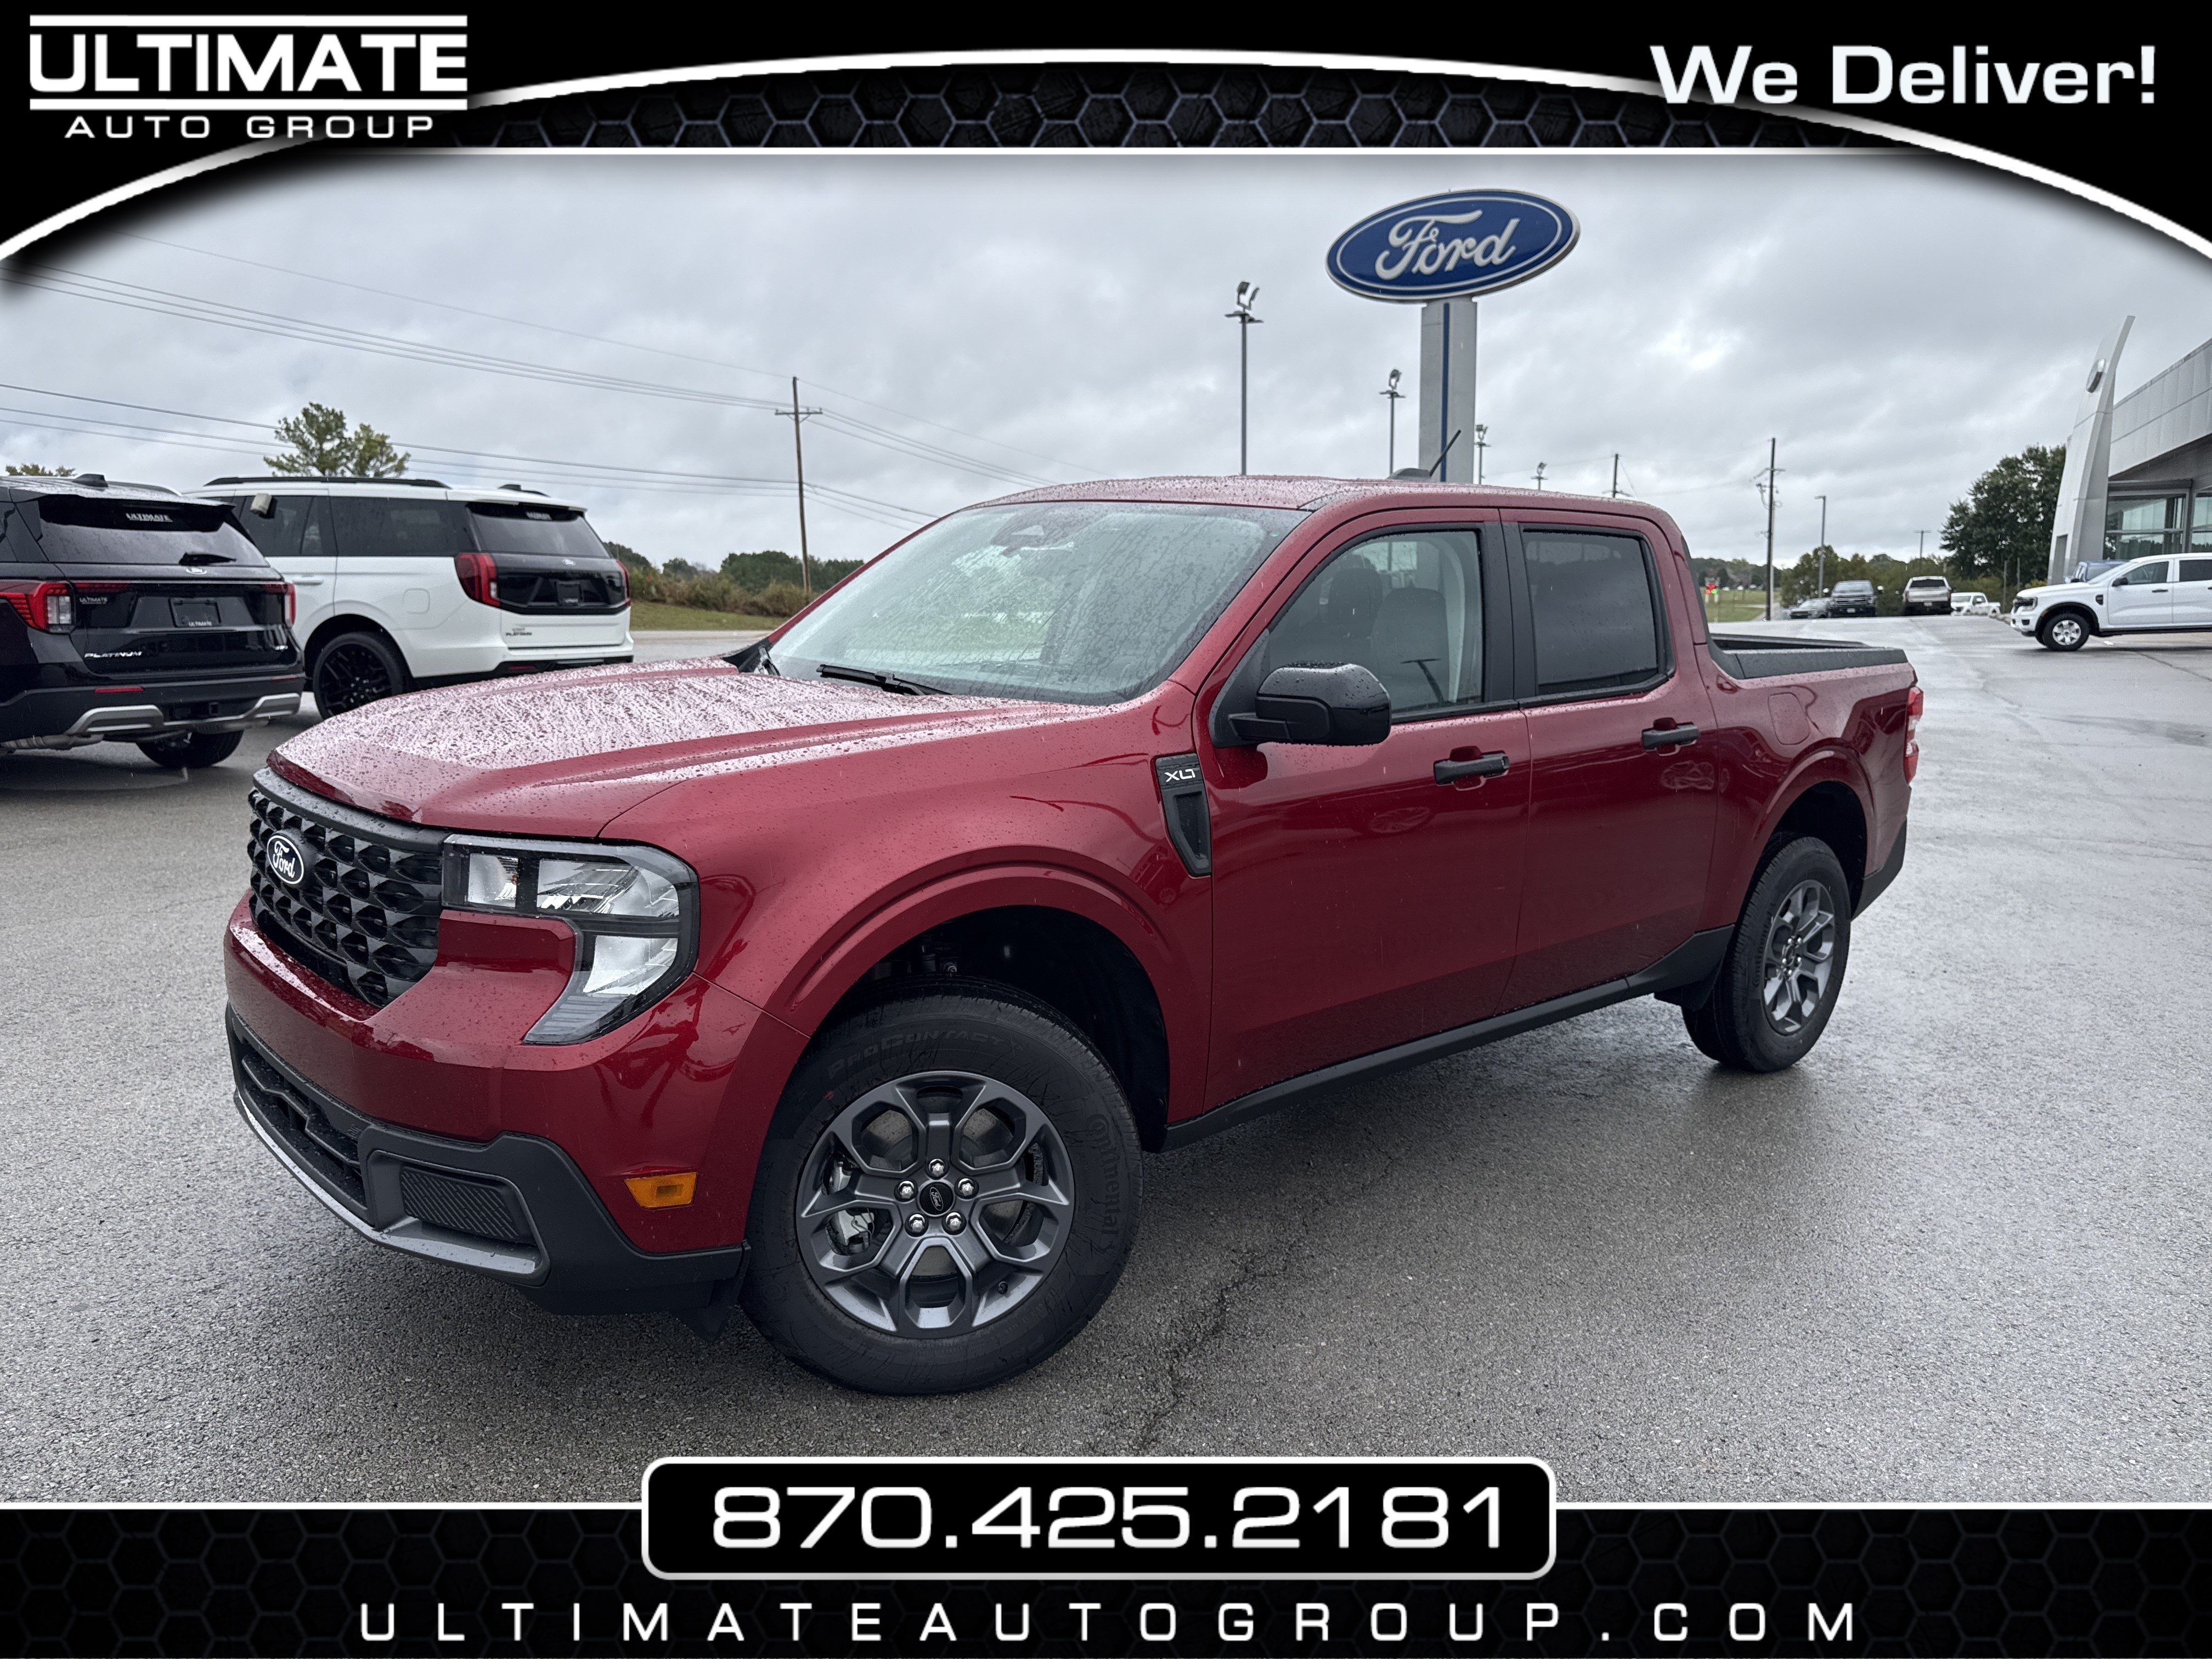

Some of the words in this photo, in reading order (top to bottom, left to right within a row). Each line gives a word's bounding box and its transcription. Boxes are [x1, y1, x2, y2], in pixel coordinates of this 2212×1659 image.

[1374, 208, 1521, 281] Ford
[125, 512, 173, 523] ULTIMATE
[1164, 768, 1197, 782] XLT
[273, 840, 296, 878] Ford
[930, 1191, 941, 1207] Ford
